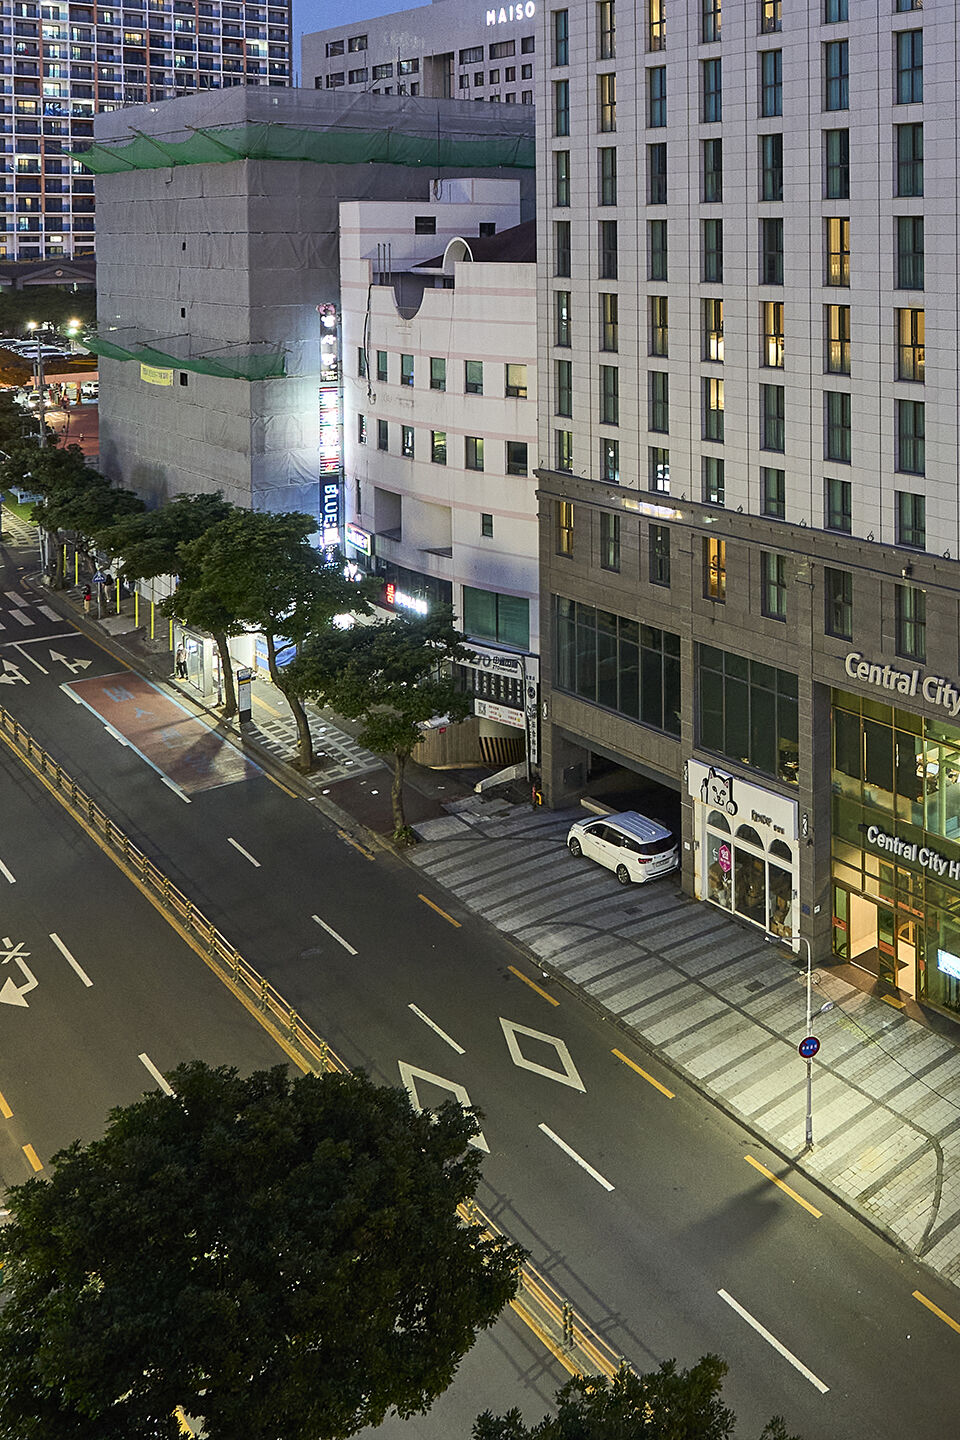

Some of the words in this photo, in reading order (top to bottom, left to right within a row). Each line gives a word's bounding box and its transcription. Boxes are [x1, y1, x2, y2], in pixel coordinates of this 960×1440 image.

[486, 0, 536, 27] MAISO
[845, 652, 919, 697] Central
[867, 825, 918, 862] Central
[918, 848, 949, 876] City
